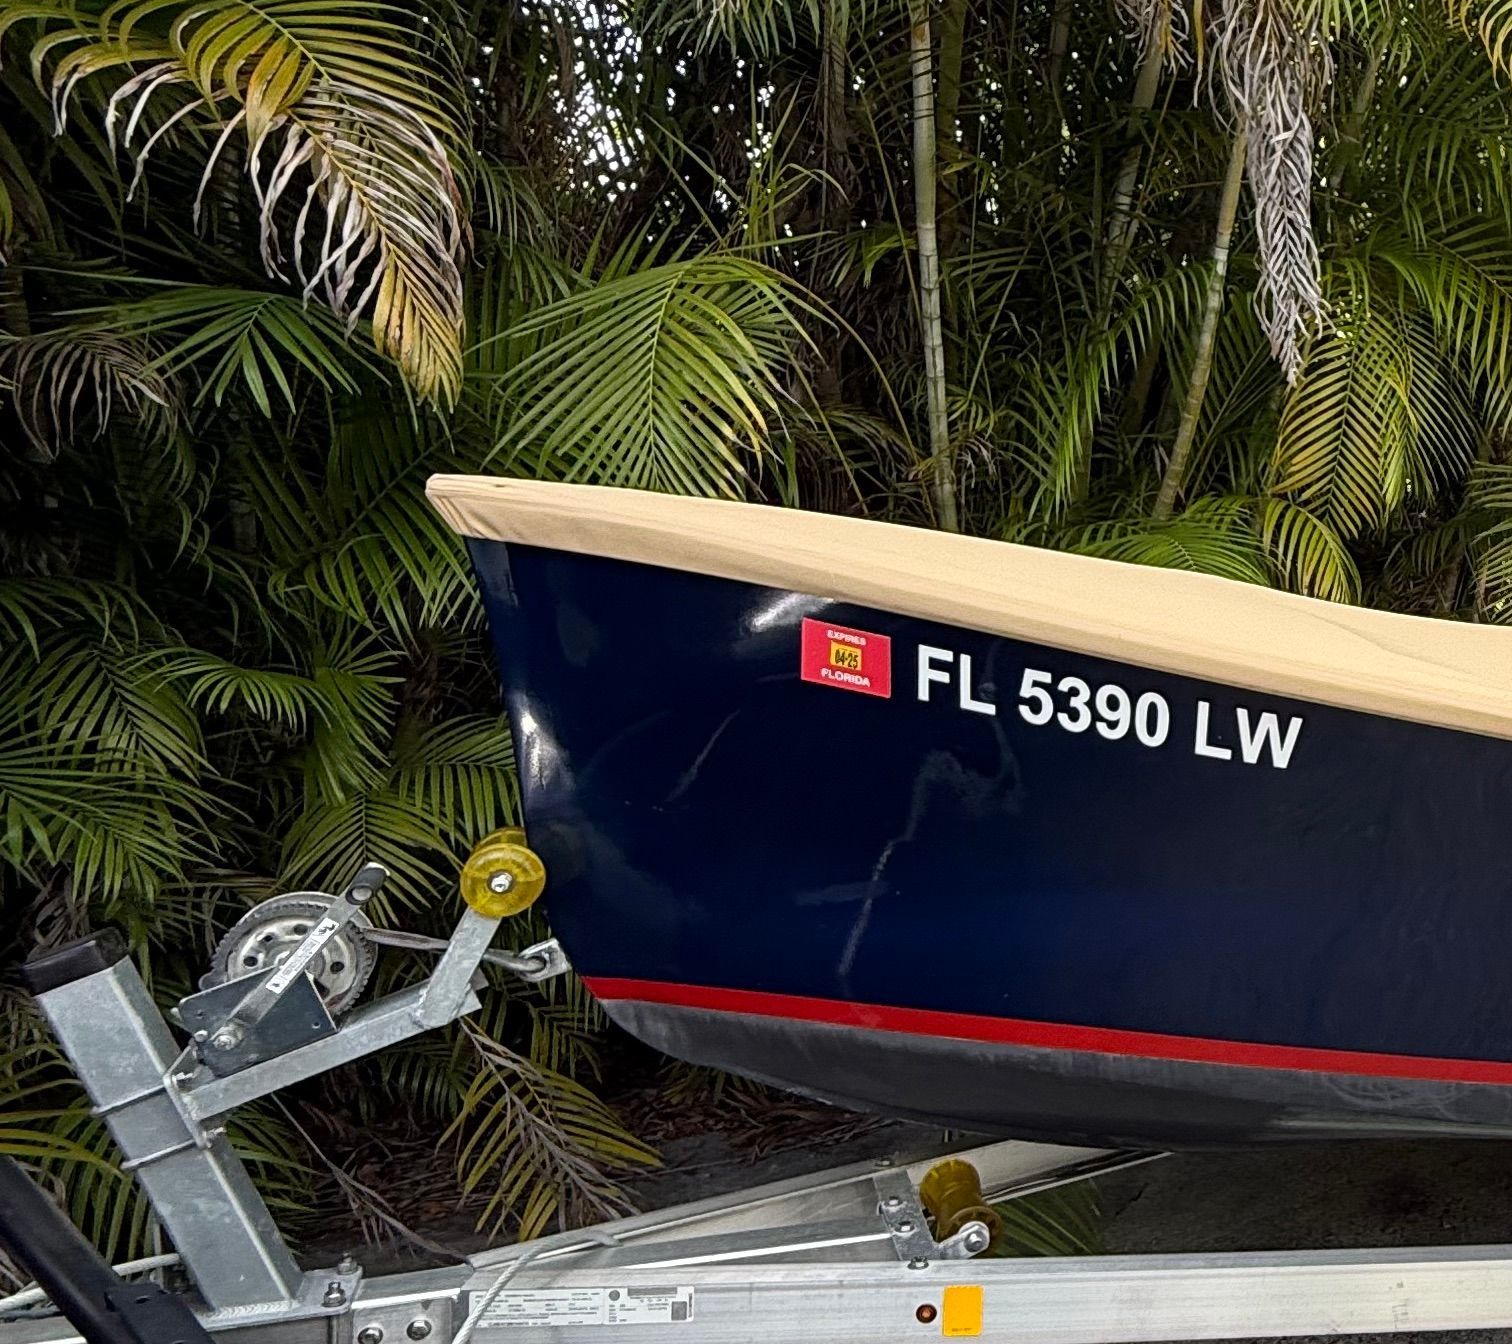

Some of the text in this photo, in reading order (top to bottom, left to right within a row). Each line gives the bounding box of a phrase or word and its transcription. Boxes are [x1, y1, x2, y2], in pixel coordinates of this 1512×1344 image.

[821, 667, 871, 687] FLORIDA
[917, 644, 1303, 769] FL 5390 LW
